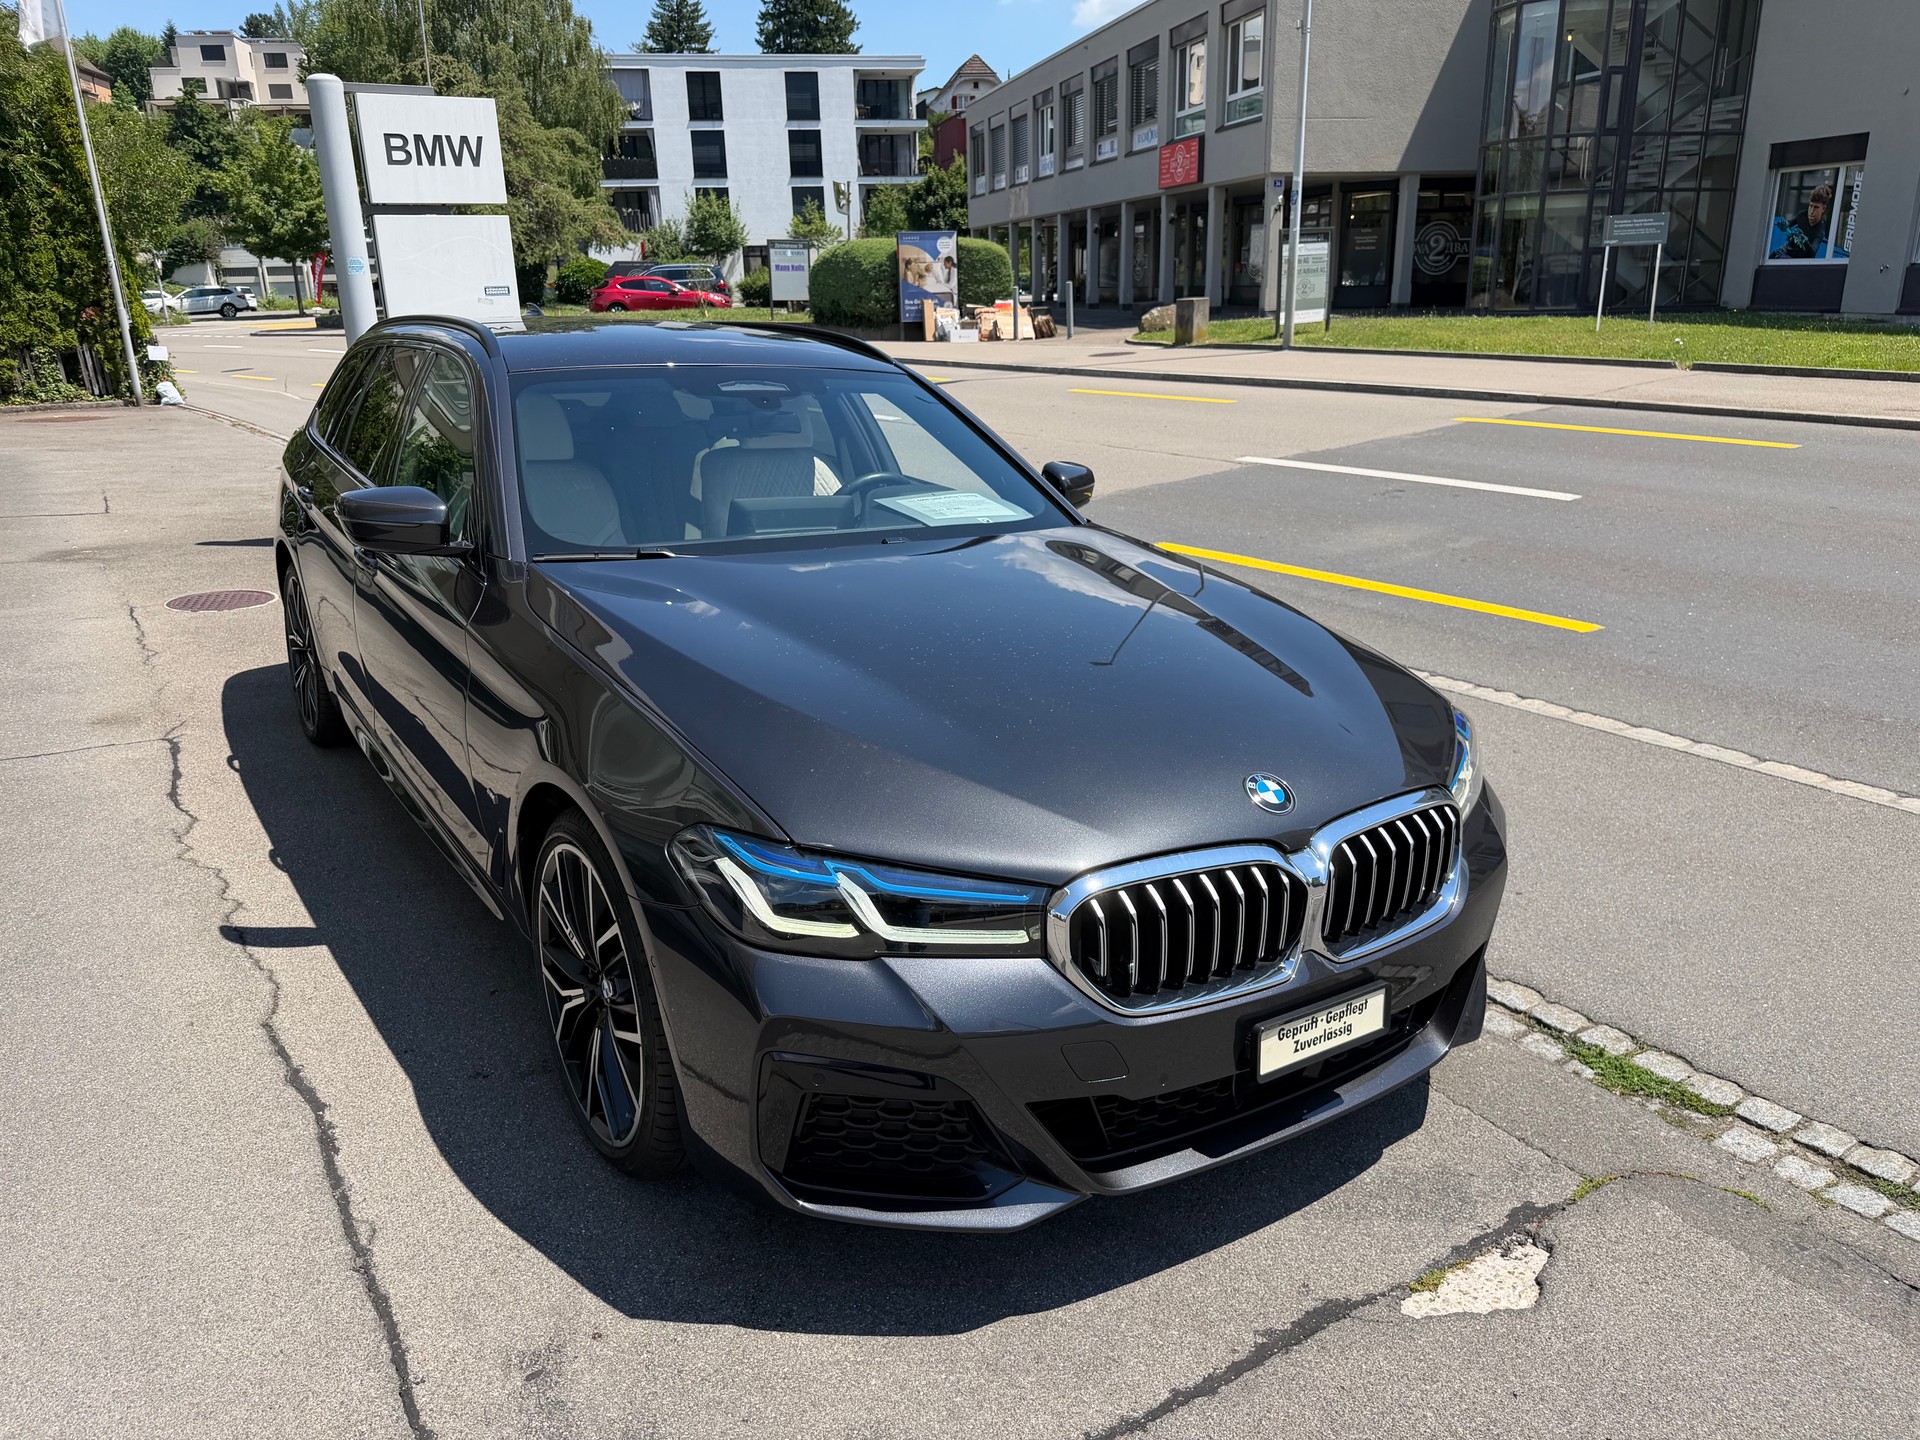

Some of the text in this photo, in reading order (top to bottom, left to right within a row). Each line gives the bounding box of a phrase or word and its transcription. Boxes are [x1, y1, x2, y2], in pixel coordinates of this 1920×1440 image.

[383, 132, 483, 167] BMW
[1843, 171, 1864, 252] GRIPMODE
[1277, 998, 1369, 1041] Geprüft Gepflegt
[1293, 1021, 1353, 1054] Zuverlässig
